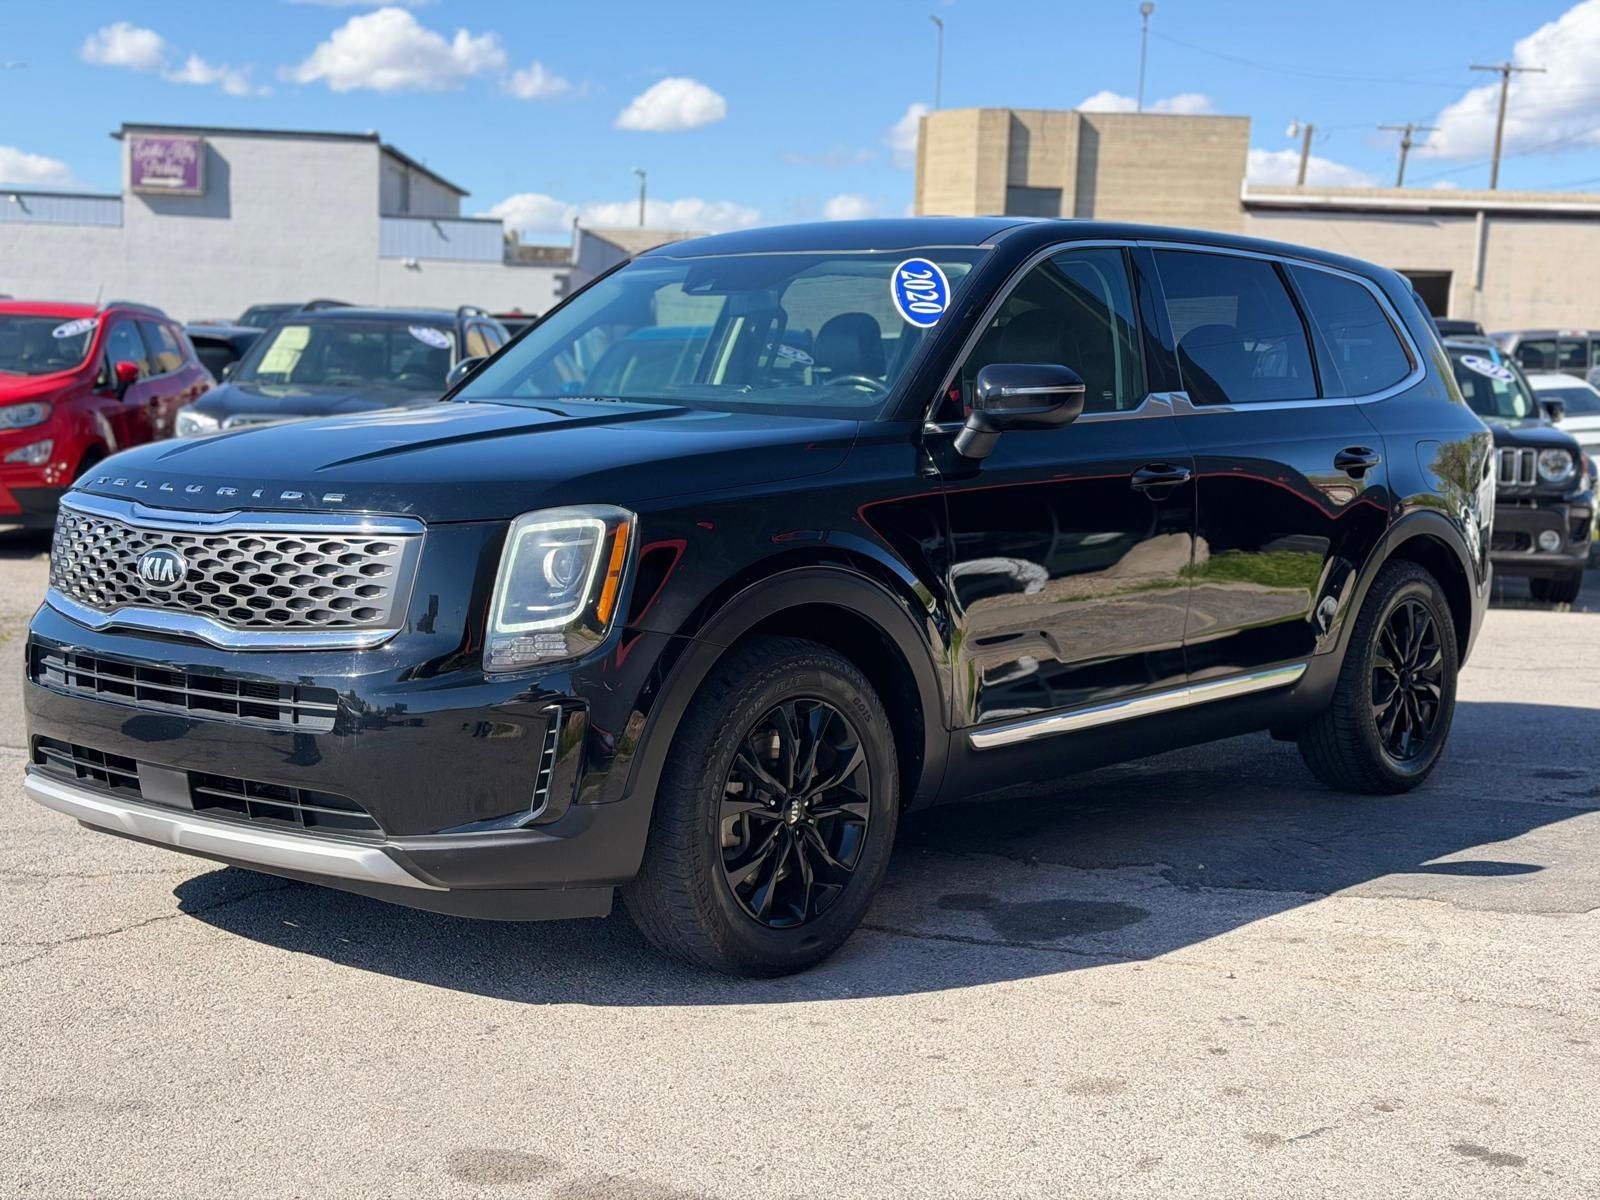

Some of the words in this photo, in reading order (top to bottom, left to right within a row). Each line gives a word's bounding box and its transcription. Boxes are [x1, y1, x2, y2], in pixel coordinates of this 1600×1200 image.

[900, 269, 943, 314] 2020
[96, 476, 347, 503] TELLURIDE
[141, 556, 175, 582] KIA
[790, 800, 799, 824] KIA
